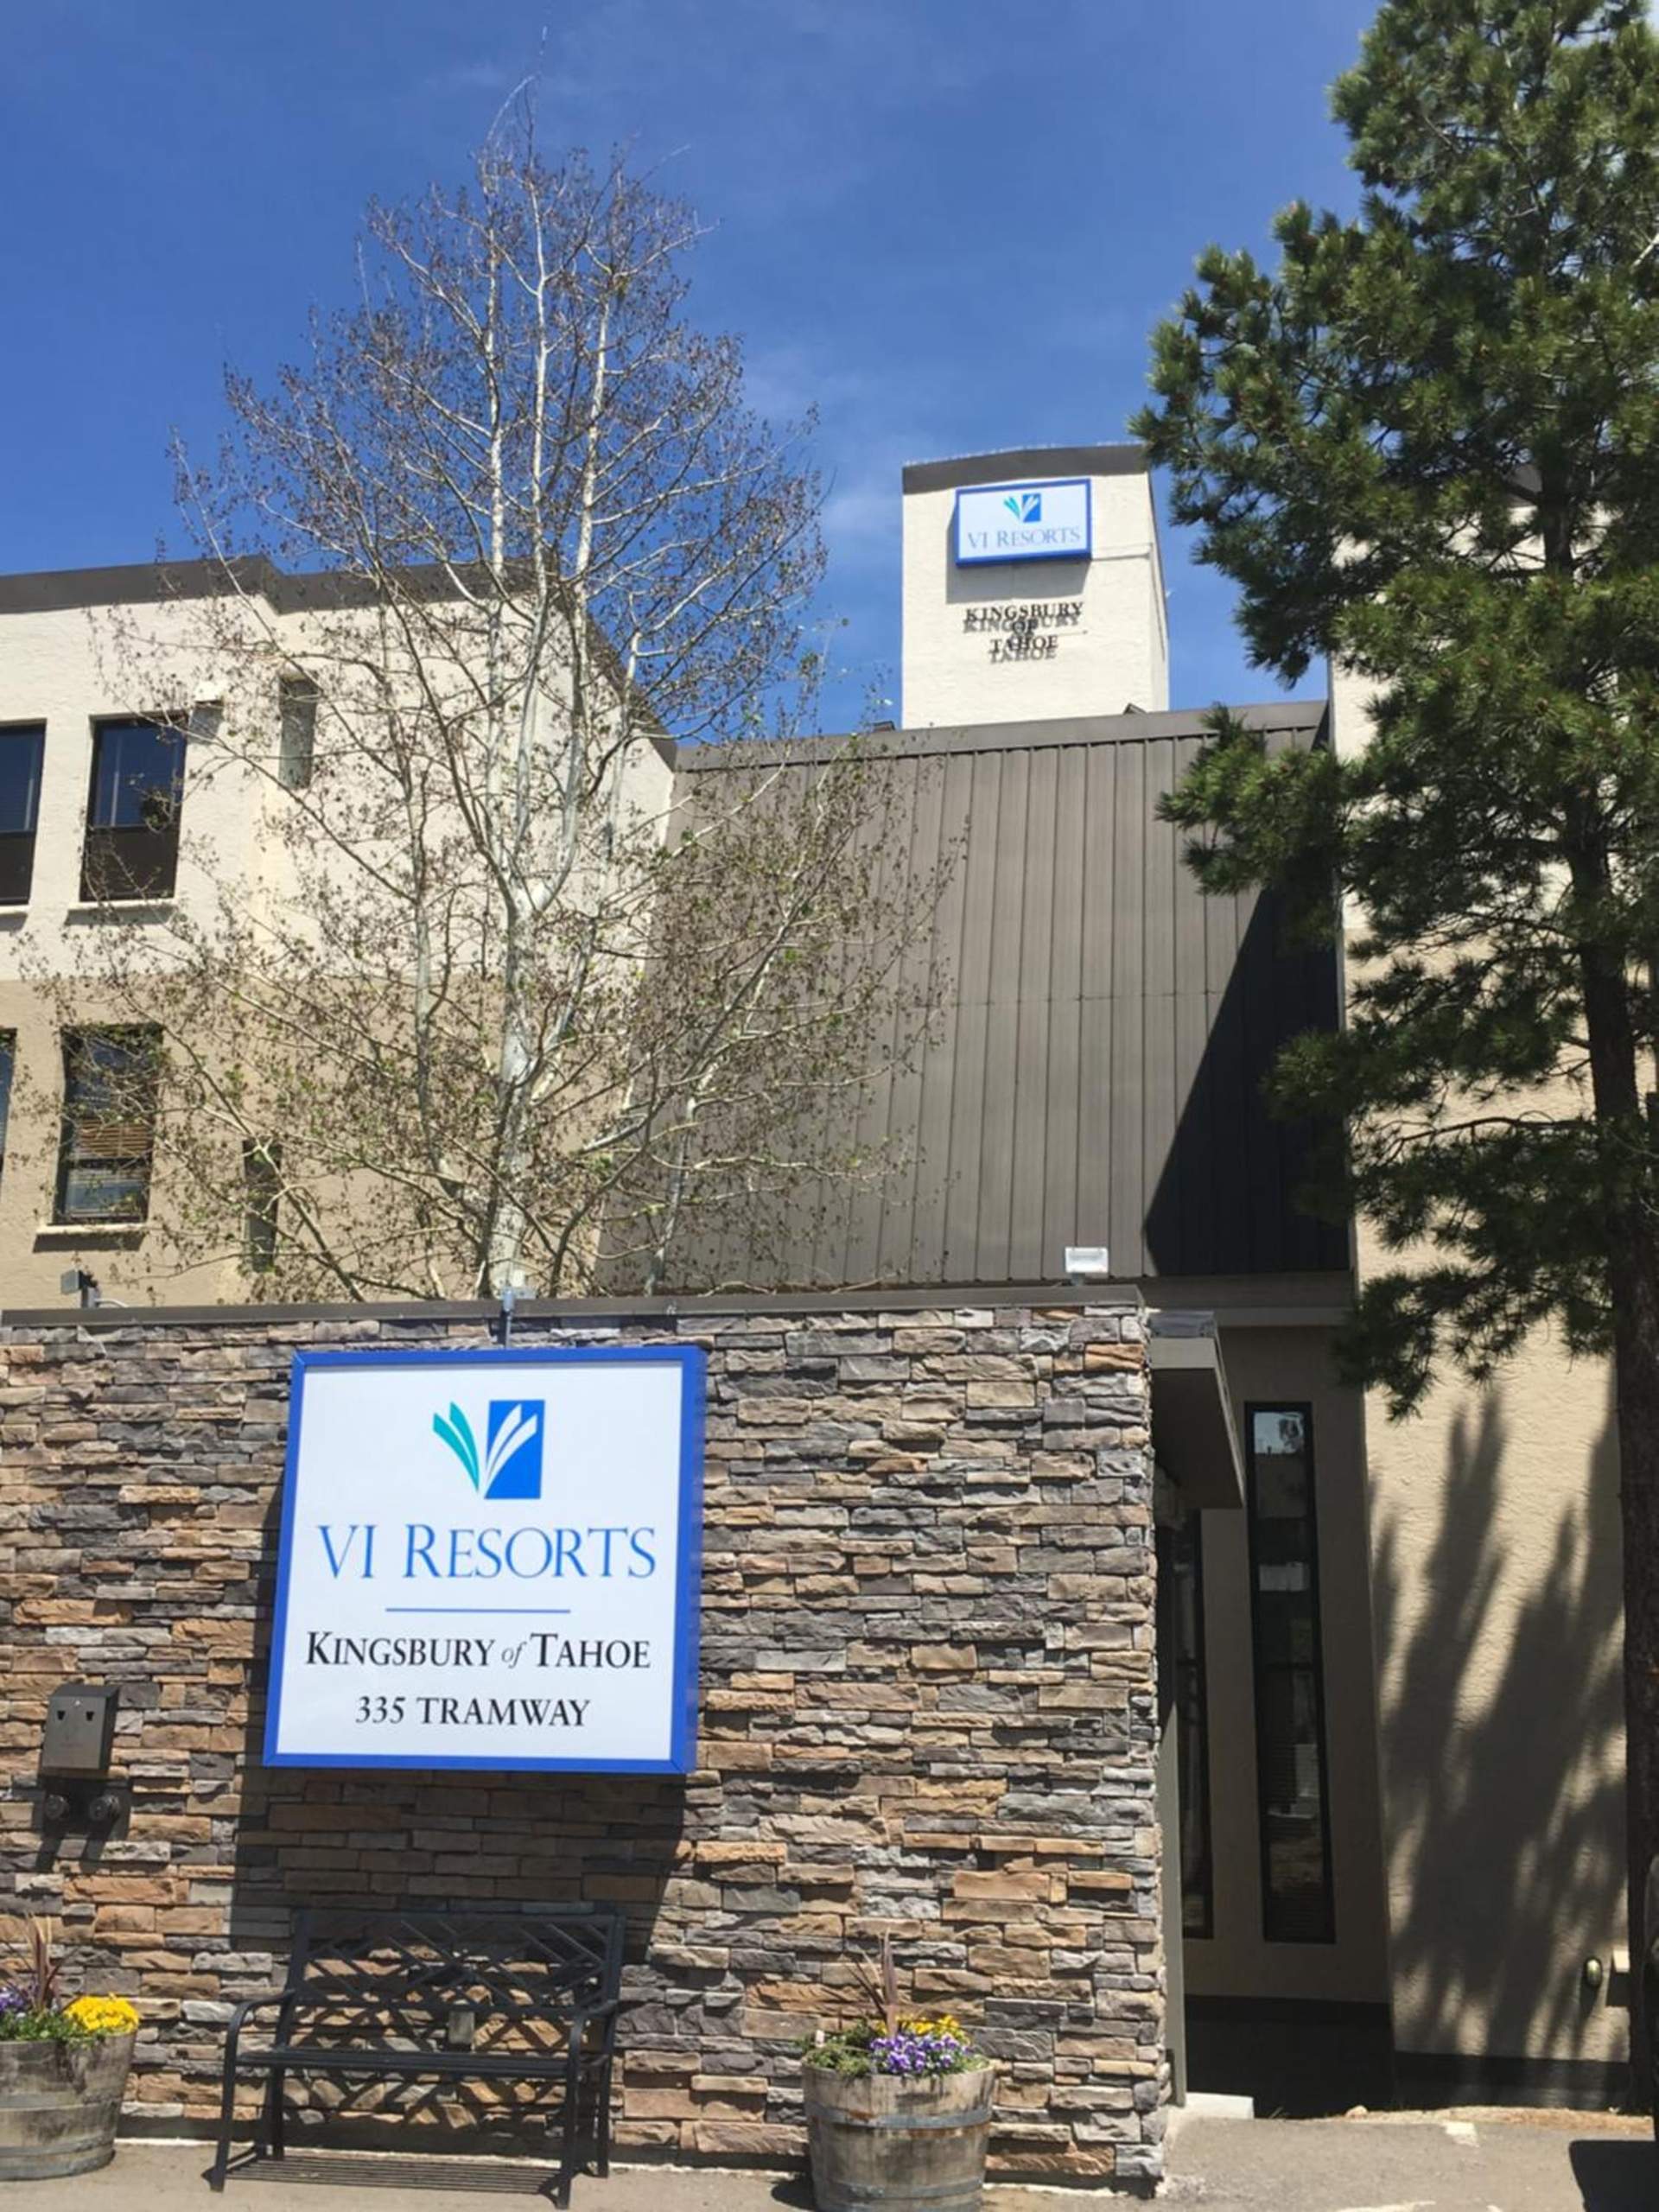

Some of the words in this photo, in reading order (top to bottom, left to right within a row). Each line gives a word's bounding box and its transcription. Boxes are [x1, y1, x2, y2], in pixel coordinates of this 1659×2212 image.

[967, 531, 988, 549] VI
[996, 526, 1080, 548] RESORTS
[965, 601, 1084, 621] KINGSBURY
[1011, 620, 1038, 637] OF
[989, 635, 1058, 653] TAHOE
[318, 1524, 378, 1580] VI
[403, 1523, 657, 1580] RESORTS
[305, 1631, 496, 1668] KINGSBURY
[500, 1641, 525, 1669] of
[530, 1633, 652, 1669] TAHOE
[354, 1696, 406, 1725] 335
[416, 1697, 591, 1726] TRAMWAY
